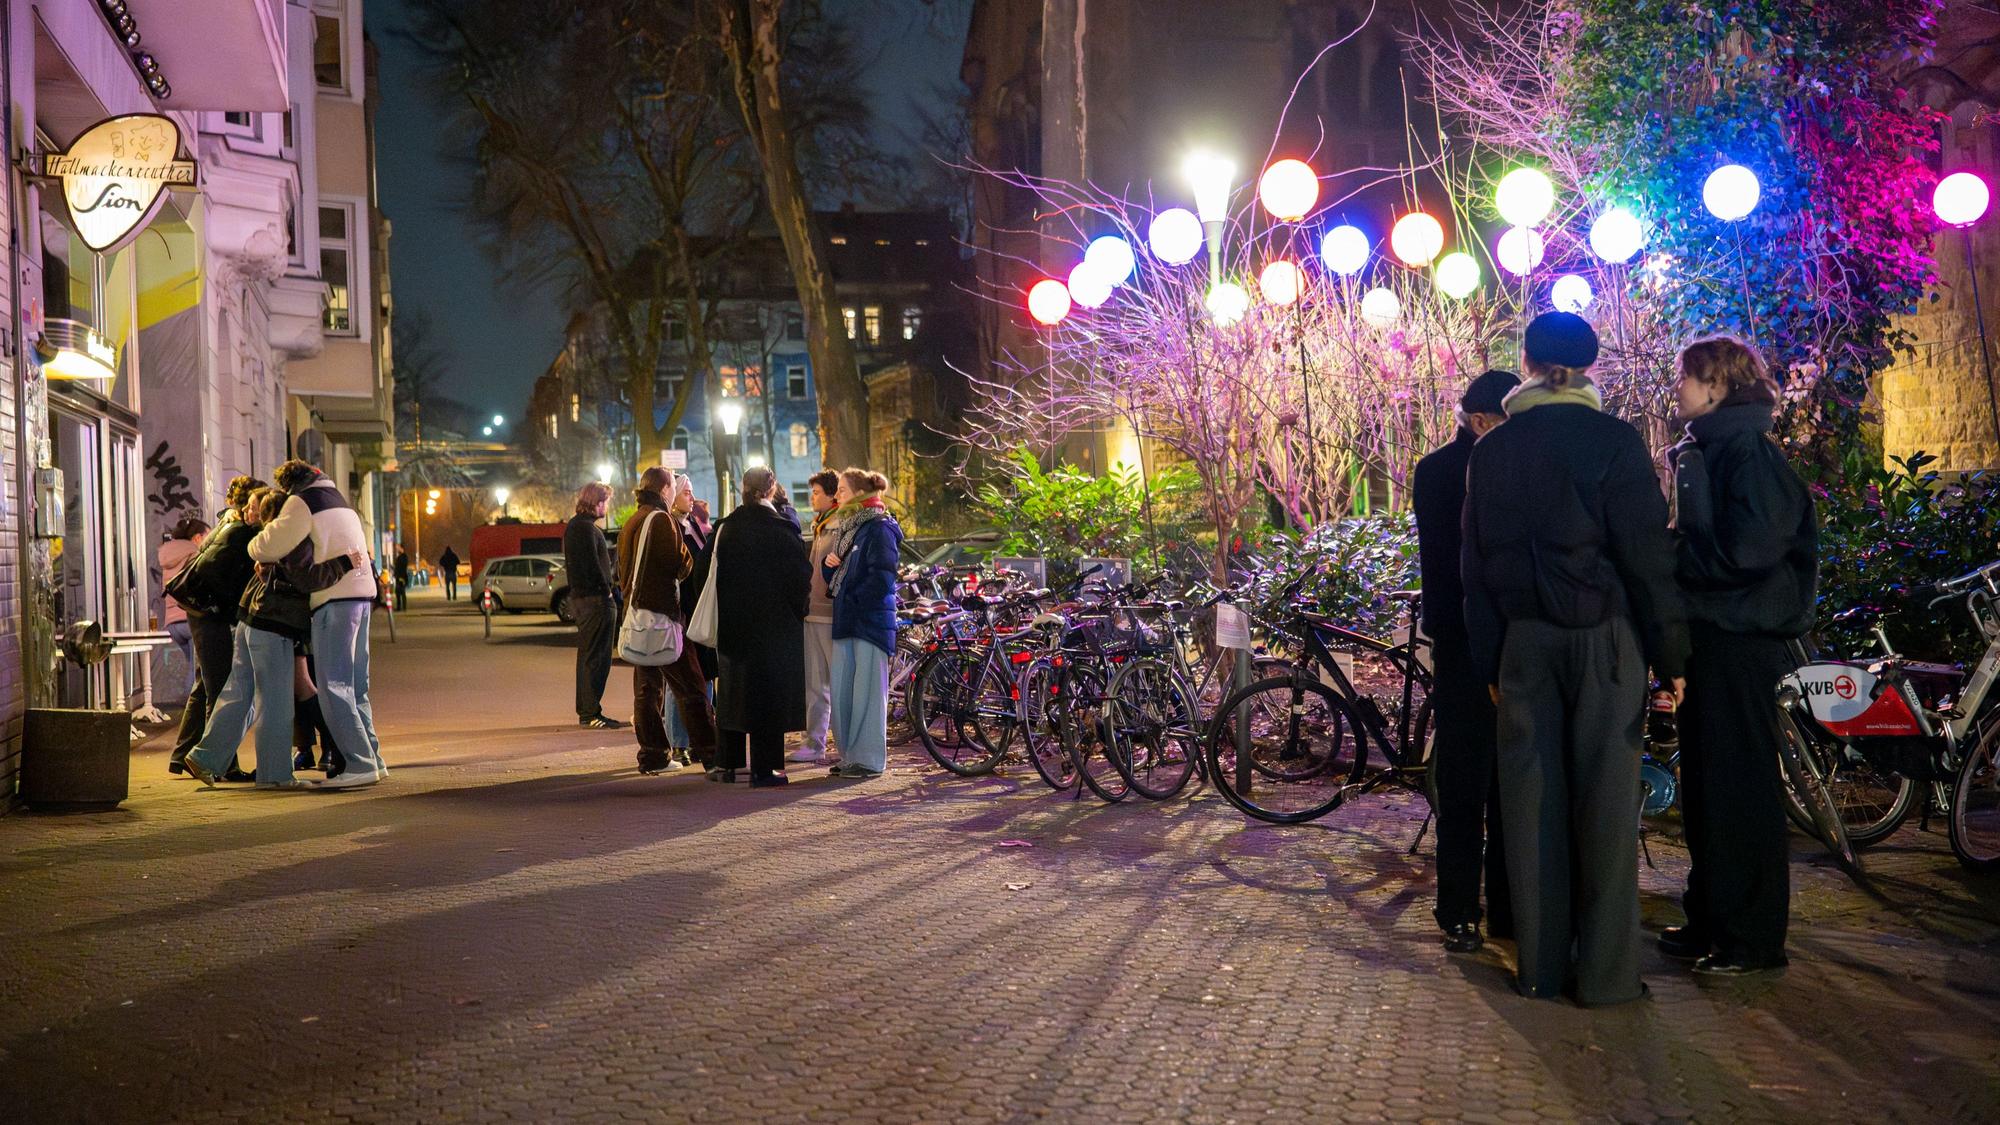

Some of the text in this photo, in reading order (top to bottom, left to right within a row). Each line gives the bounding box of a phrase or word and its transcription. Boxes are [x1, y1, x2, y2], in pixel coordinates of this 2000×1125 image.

[47, 156, 194, 182] Hallmackenreuther
[72, 182, 144, 214] Sion
[1805, 681, 1834, 695] KVB
